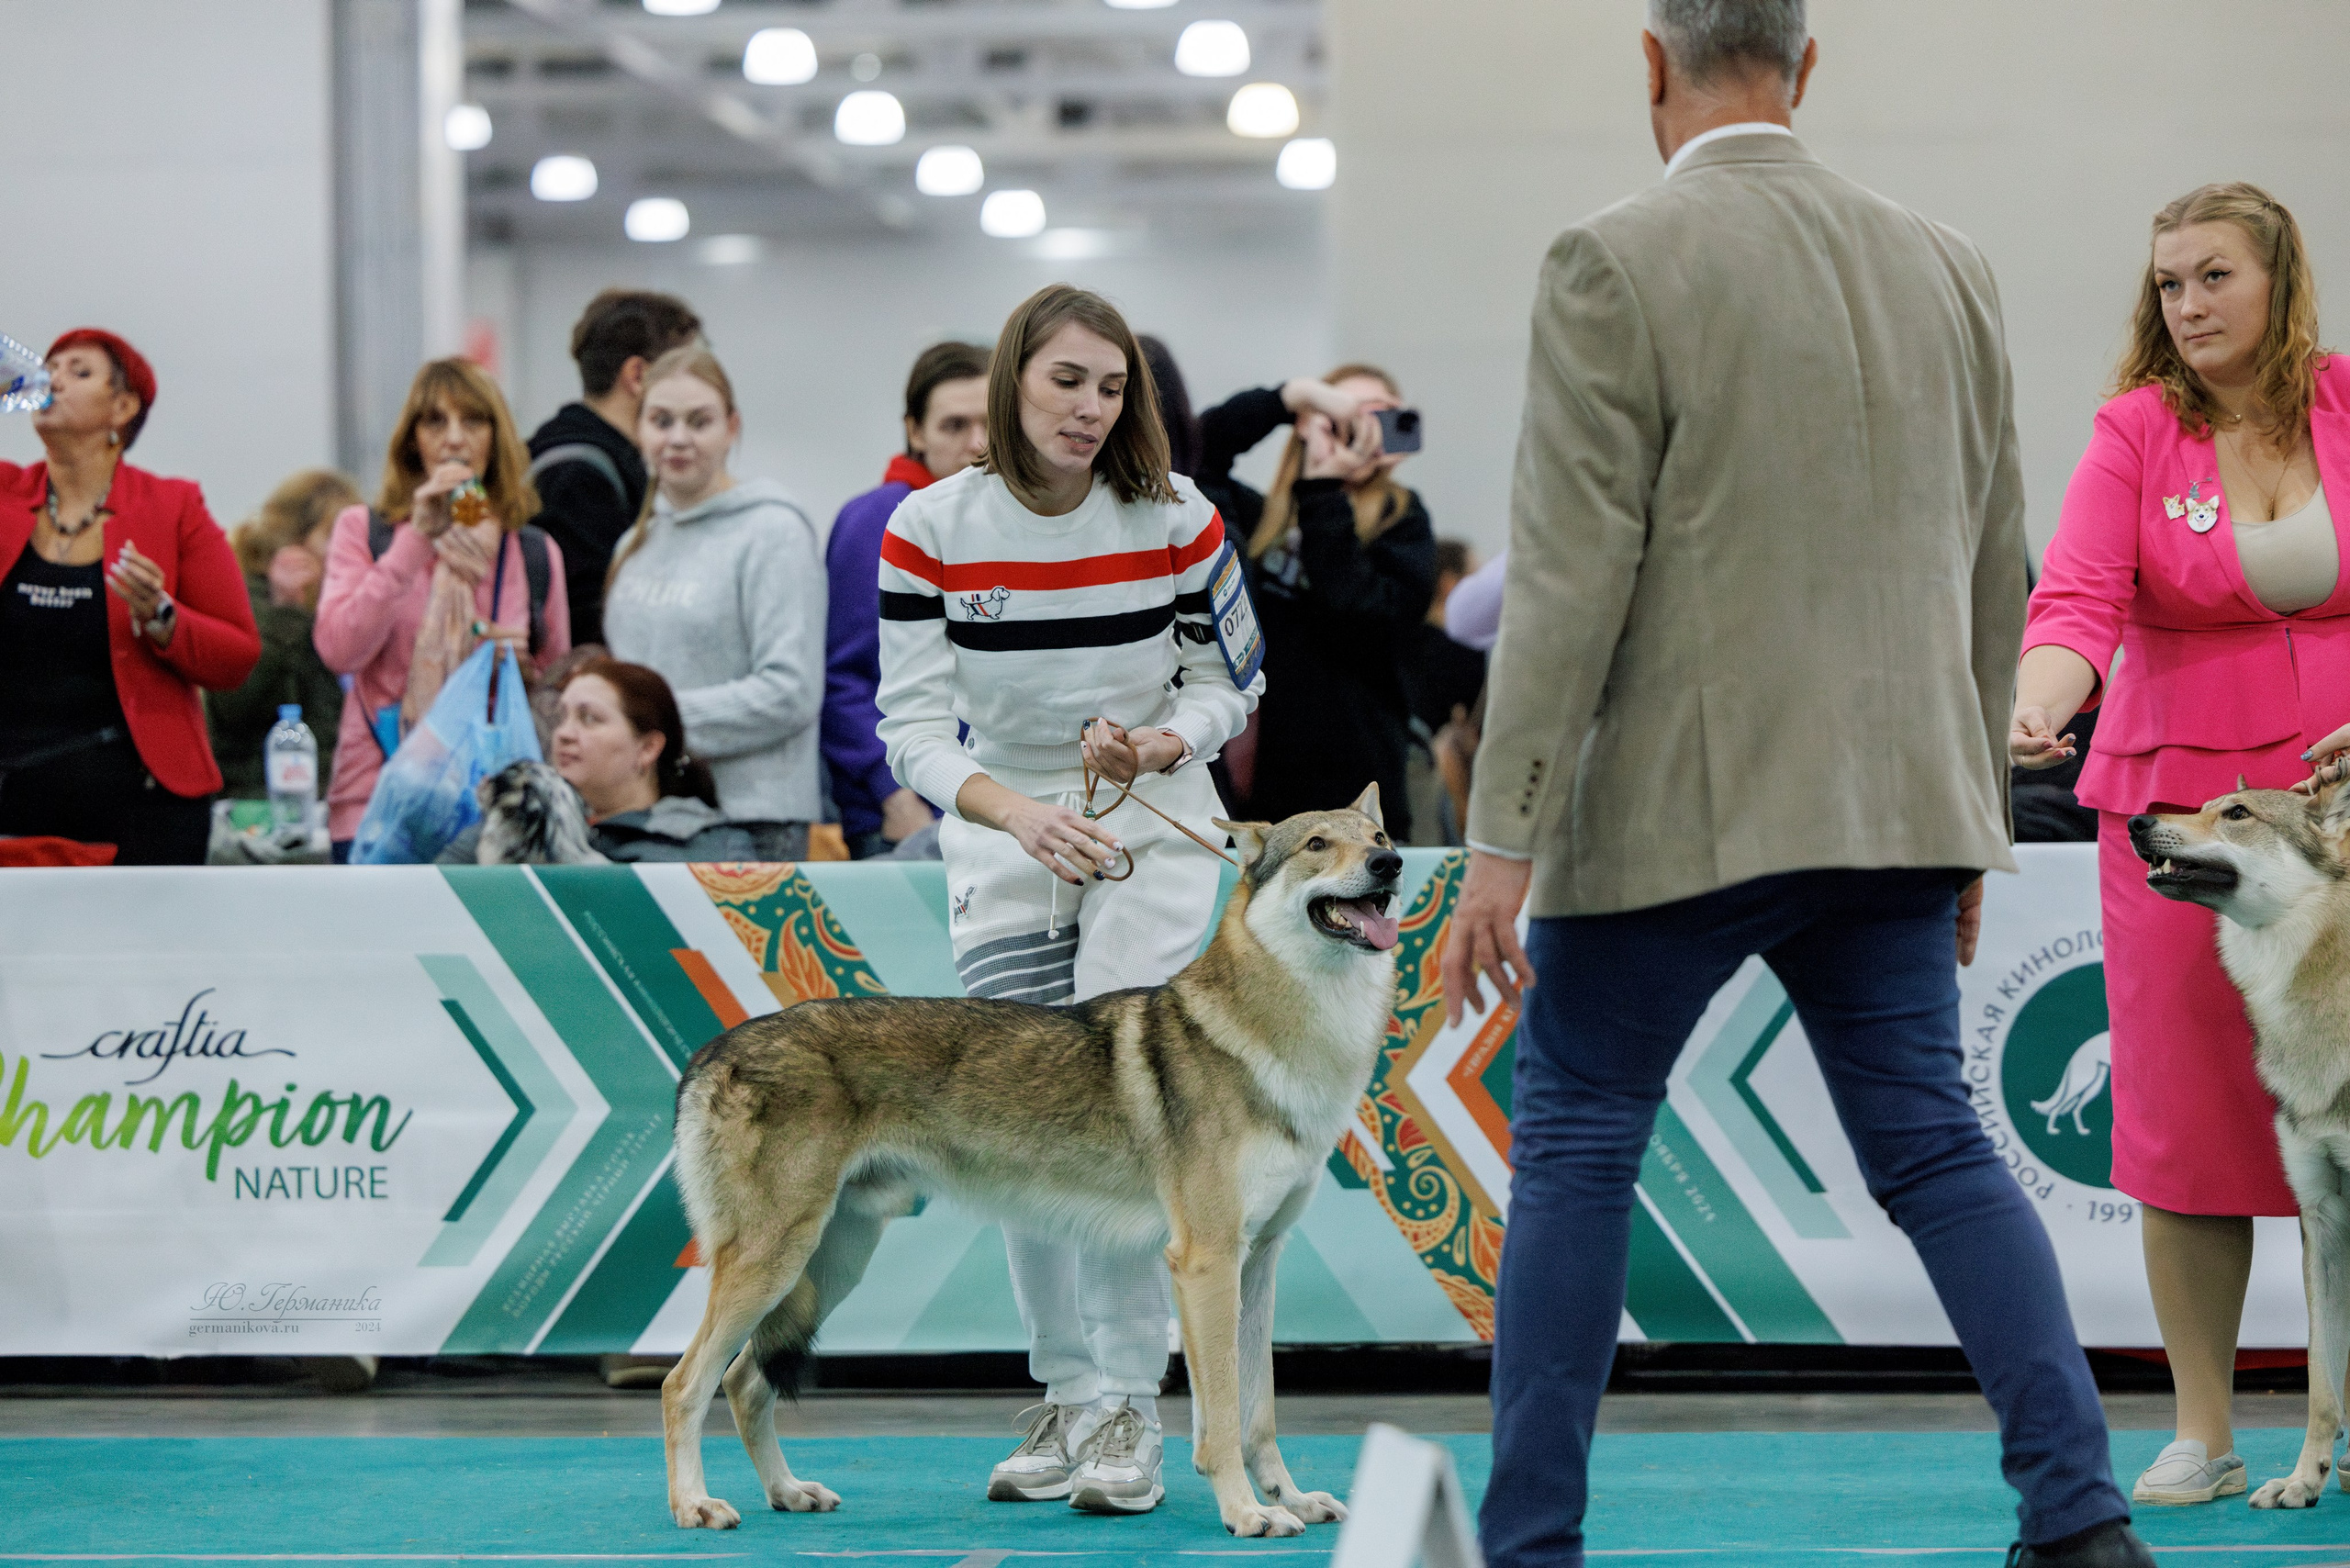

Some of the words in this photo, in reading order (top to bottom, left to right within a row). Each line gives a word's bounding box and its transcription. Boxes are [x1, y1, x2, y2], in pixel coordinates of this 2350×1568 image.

[39, 988, 297, 1086] craftia
[0, 1050, 413, 1182] hampion
[234, 1166, 389, 1200] NATURE
[1685, 1186, 1718, 1223] 2024
